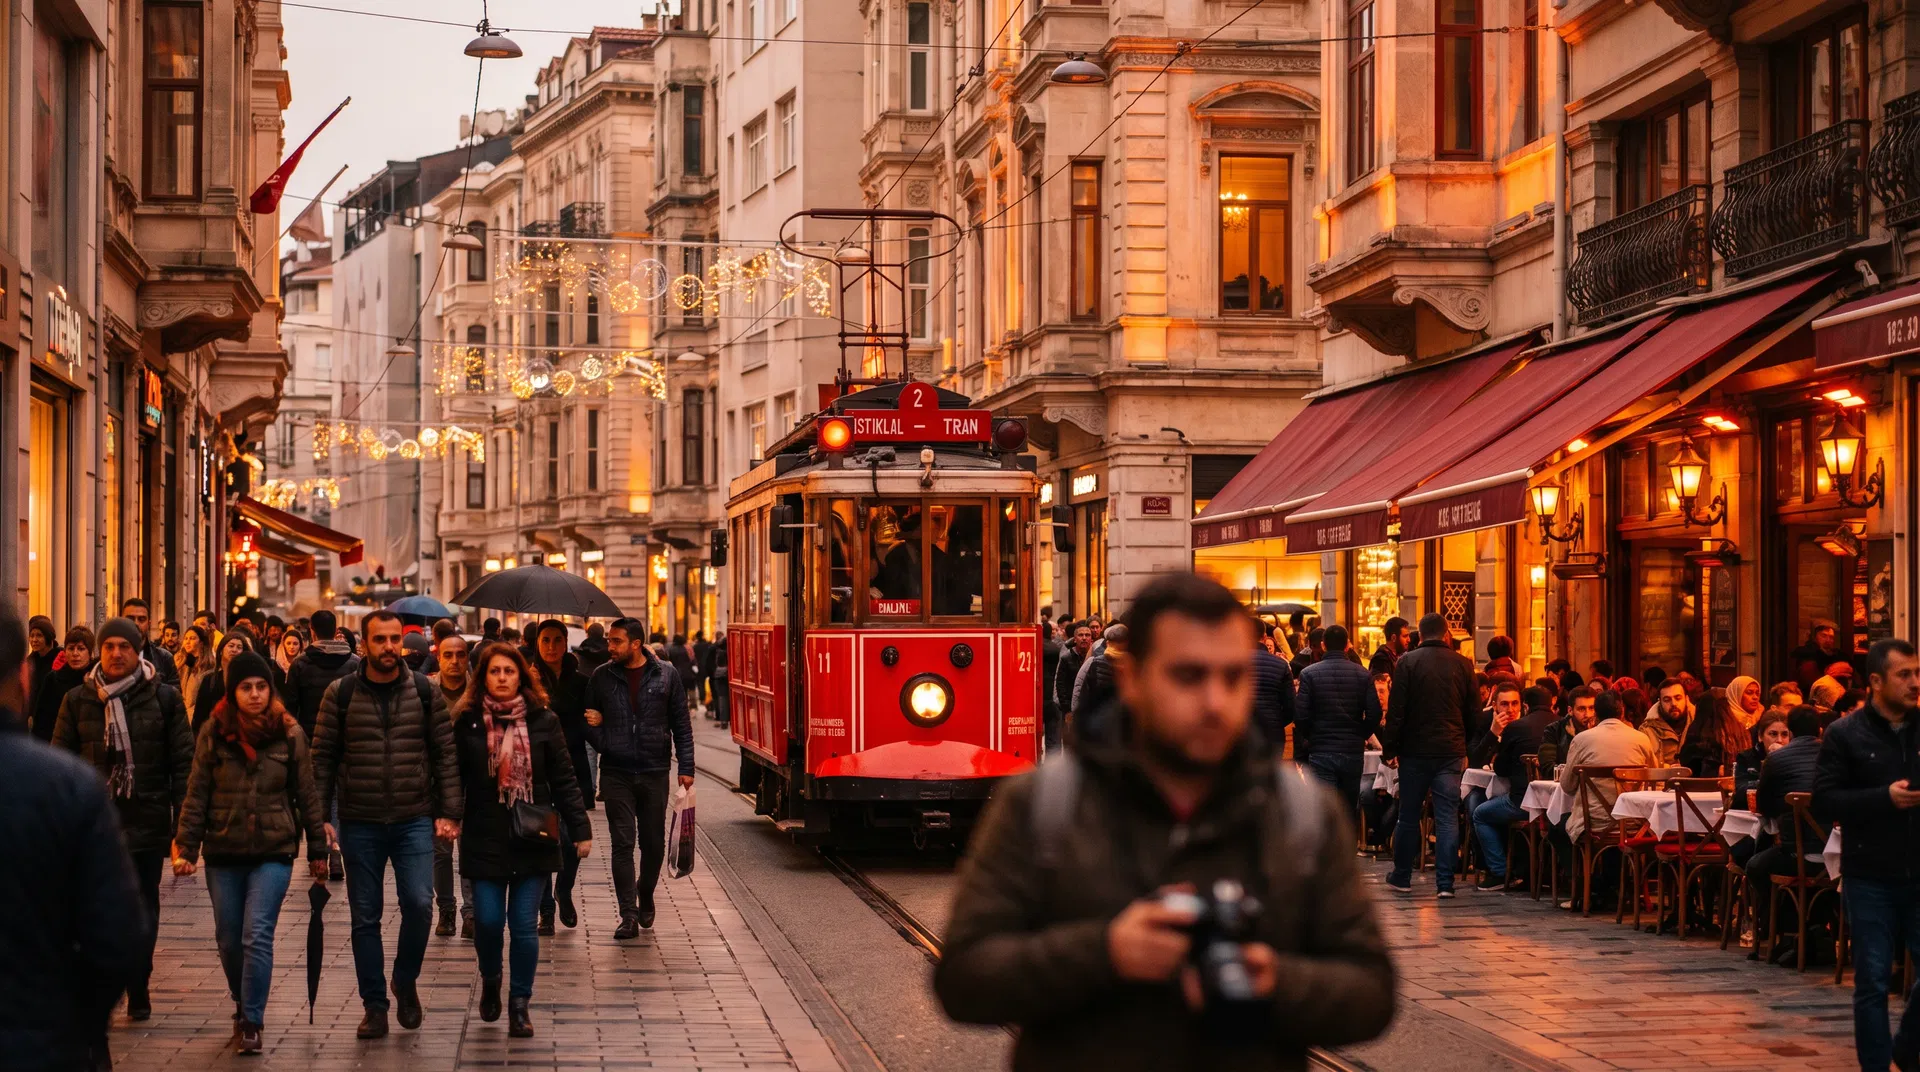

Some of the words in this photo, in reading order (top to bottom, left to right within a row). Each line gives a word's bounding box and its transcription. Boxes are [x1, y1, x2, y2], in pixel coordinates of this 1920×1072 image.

[913, 388, 923, 408] 2
[853, 418, 904, 435] ISTIKLAL
[943, 418, 979, 435] TRAN
[818, 652, 831, 674] 11
